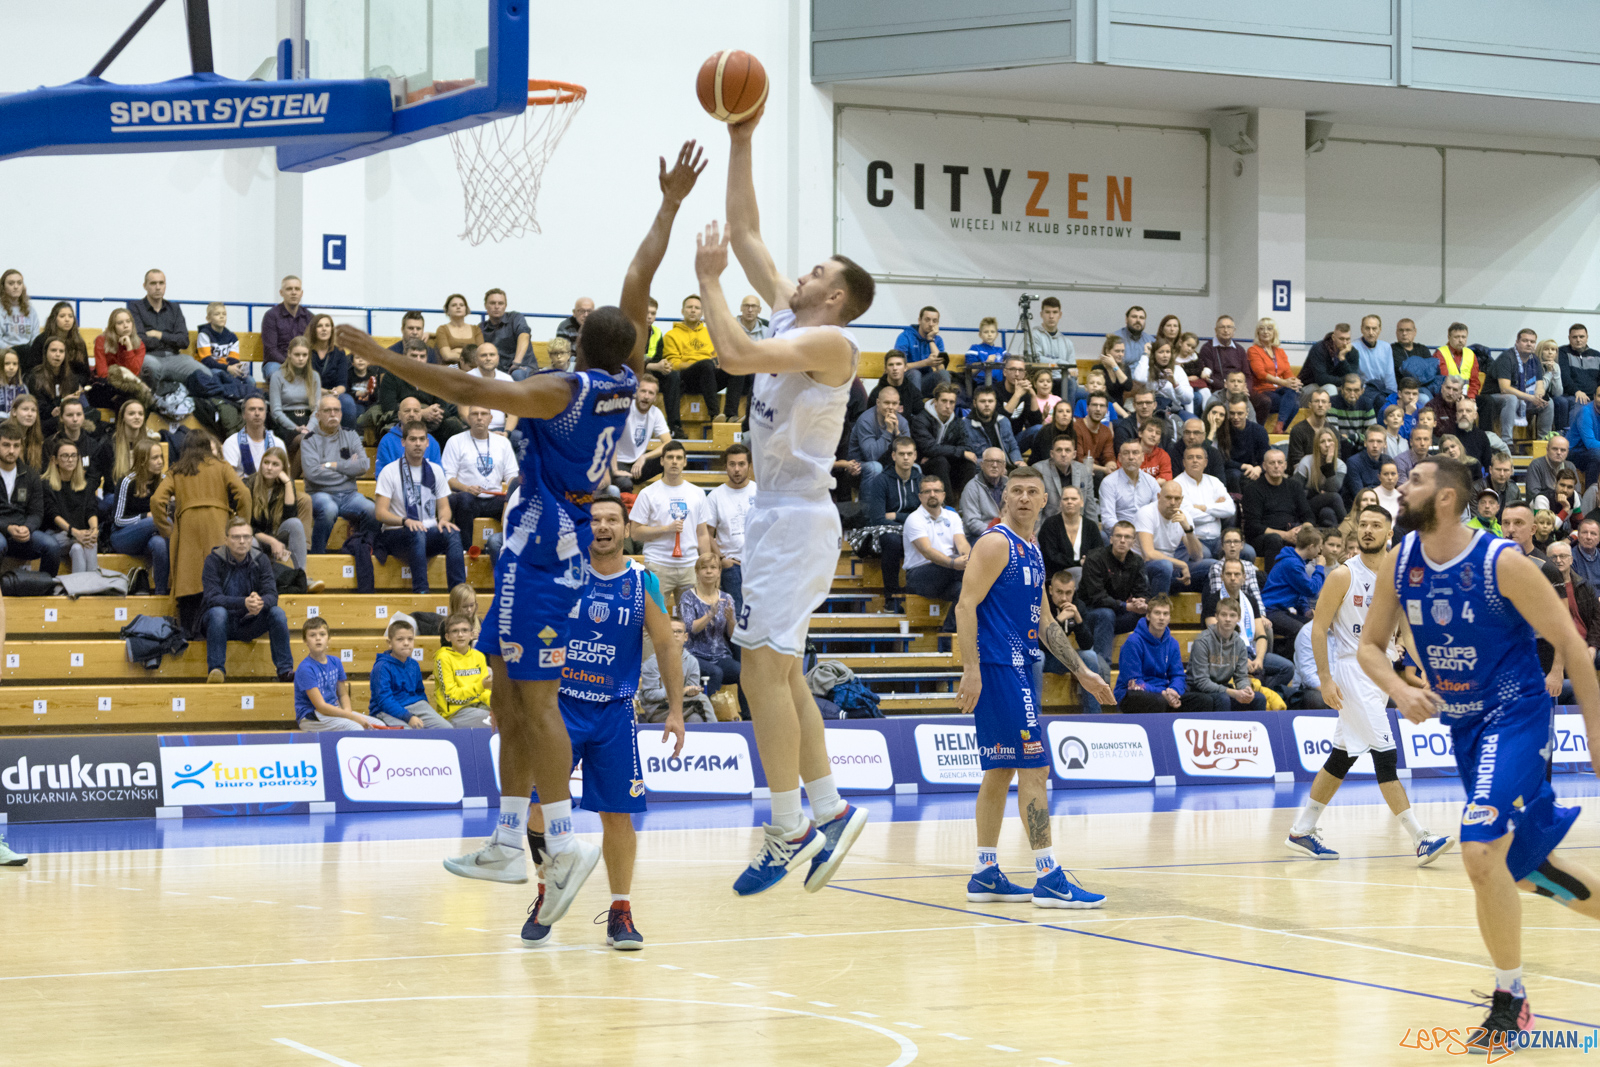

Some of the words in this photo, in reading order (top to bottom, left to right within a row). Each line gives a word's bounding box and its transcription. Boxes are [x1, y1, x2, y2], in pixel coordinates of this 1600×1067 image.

[866, 160, 1133, 222] CITYZEN
[950, 217, 996, 232] WIĘCEJ
[1028, 222, 1060, 234] KLUB
[1066, 224, 1133, 239] SPORTOWY
[326, 240, 342, 265] C
[1275, 284, 1288, 308] B
[586, 426, 616, 482] 0
[498, 562, 517, 636] PRUDNIK
[618, 606, 630, 626] 11
[1462, 600, 1476, 624] 4
[562, 667, 605, 684] Cichon
[1022, 688, 1038, 728] POGOŃ
[979, 742, 1016, 758] Optima
[1091, 742, 1143, 750] DIAGNOSTYKA
[1092, 750, 1144, 758] OBRAZOWA
[1213, 741, 1258, 756] Danuty
[2, 754, 157, 790] drukma
[212, 760, 317, 780] funclub
[387, 766, 452, 780] posnania
[647, 755, 739, 773] BIOFARM
[1473, 734, 1499, 800] PRUDNIK
[259, 779, 317, 788] podróży
[6, 792, 78, 805] DRUKARNIA
[82, 787, 158, 801] SKOCZYŃSKI
[1469, 810, 1490, 820] LOTTO
